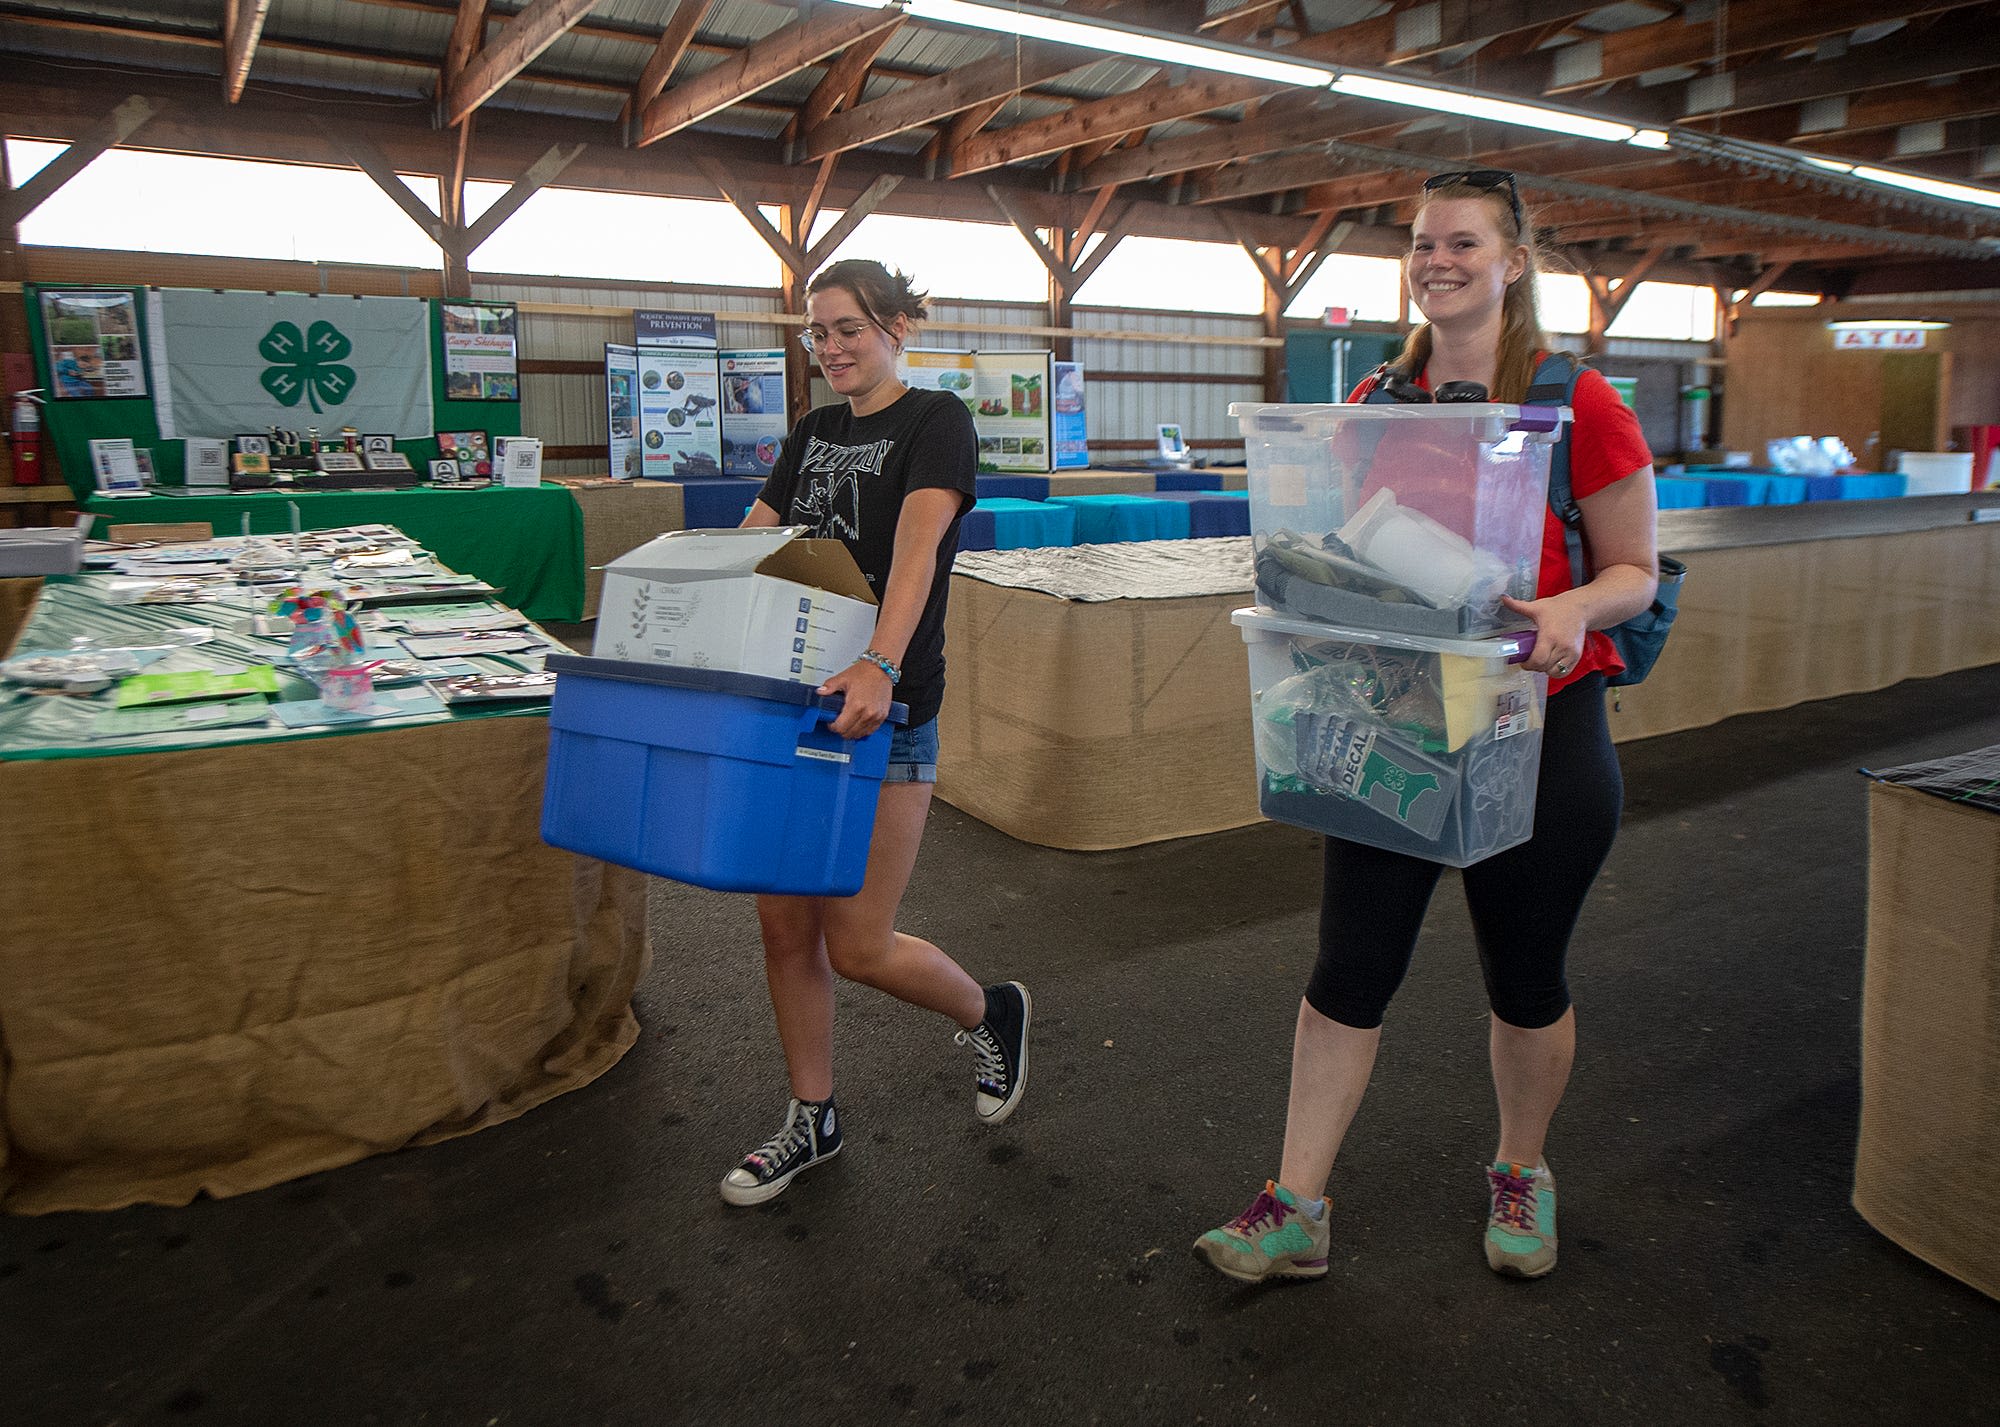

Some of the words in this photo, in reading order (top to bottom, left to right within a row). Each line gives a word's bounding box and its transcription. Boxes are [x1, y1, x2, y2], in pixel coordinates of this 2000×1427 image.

[640, 312, 664, 320] AQUATIC
[650, 320, 702, 330] PREVENTION
[268, 332, 294, 354] H
[316, 332, 341, 353] H
[447, 336, 472, 348] Camp
[1843, 331, 1919, 344] ATM
[272, 374, 297, 395] H
[322, 372, 347, 394] H
[1342, 733, 1370, 787] DECAL
